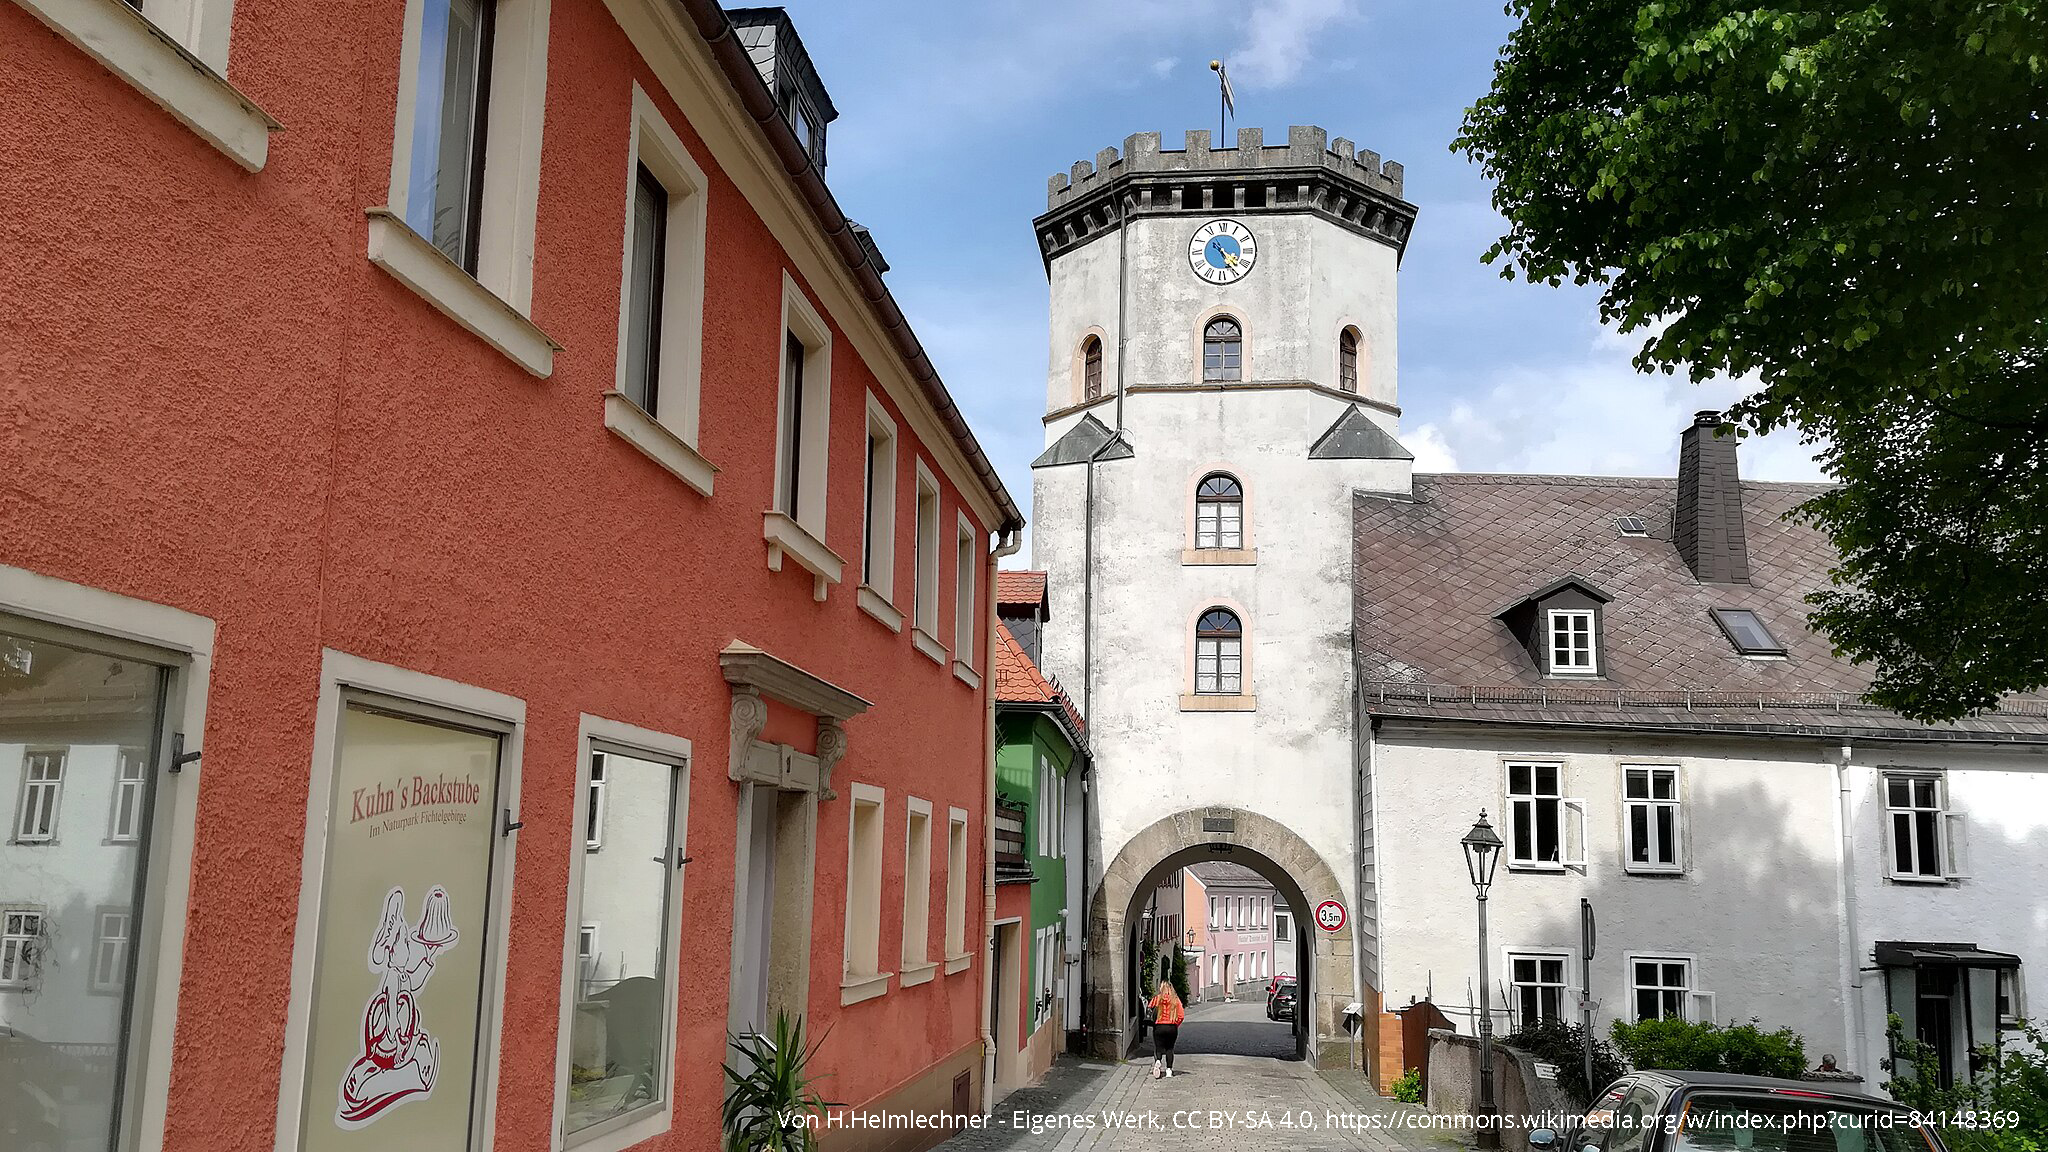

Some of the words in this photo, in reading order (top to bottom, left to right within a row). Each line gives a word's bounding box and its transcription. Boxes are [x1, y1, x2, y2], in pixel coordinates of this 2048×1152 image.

[411, 773, 480, 808] Backstube
[369, 824, 380, 838] Im
[382, 812, 419, 834] Naturpark
[420, 809, 467, 824] Fichtelgebirge
